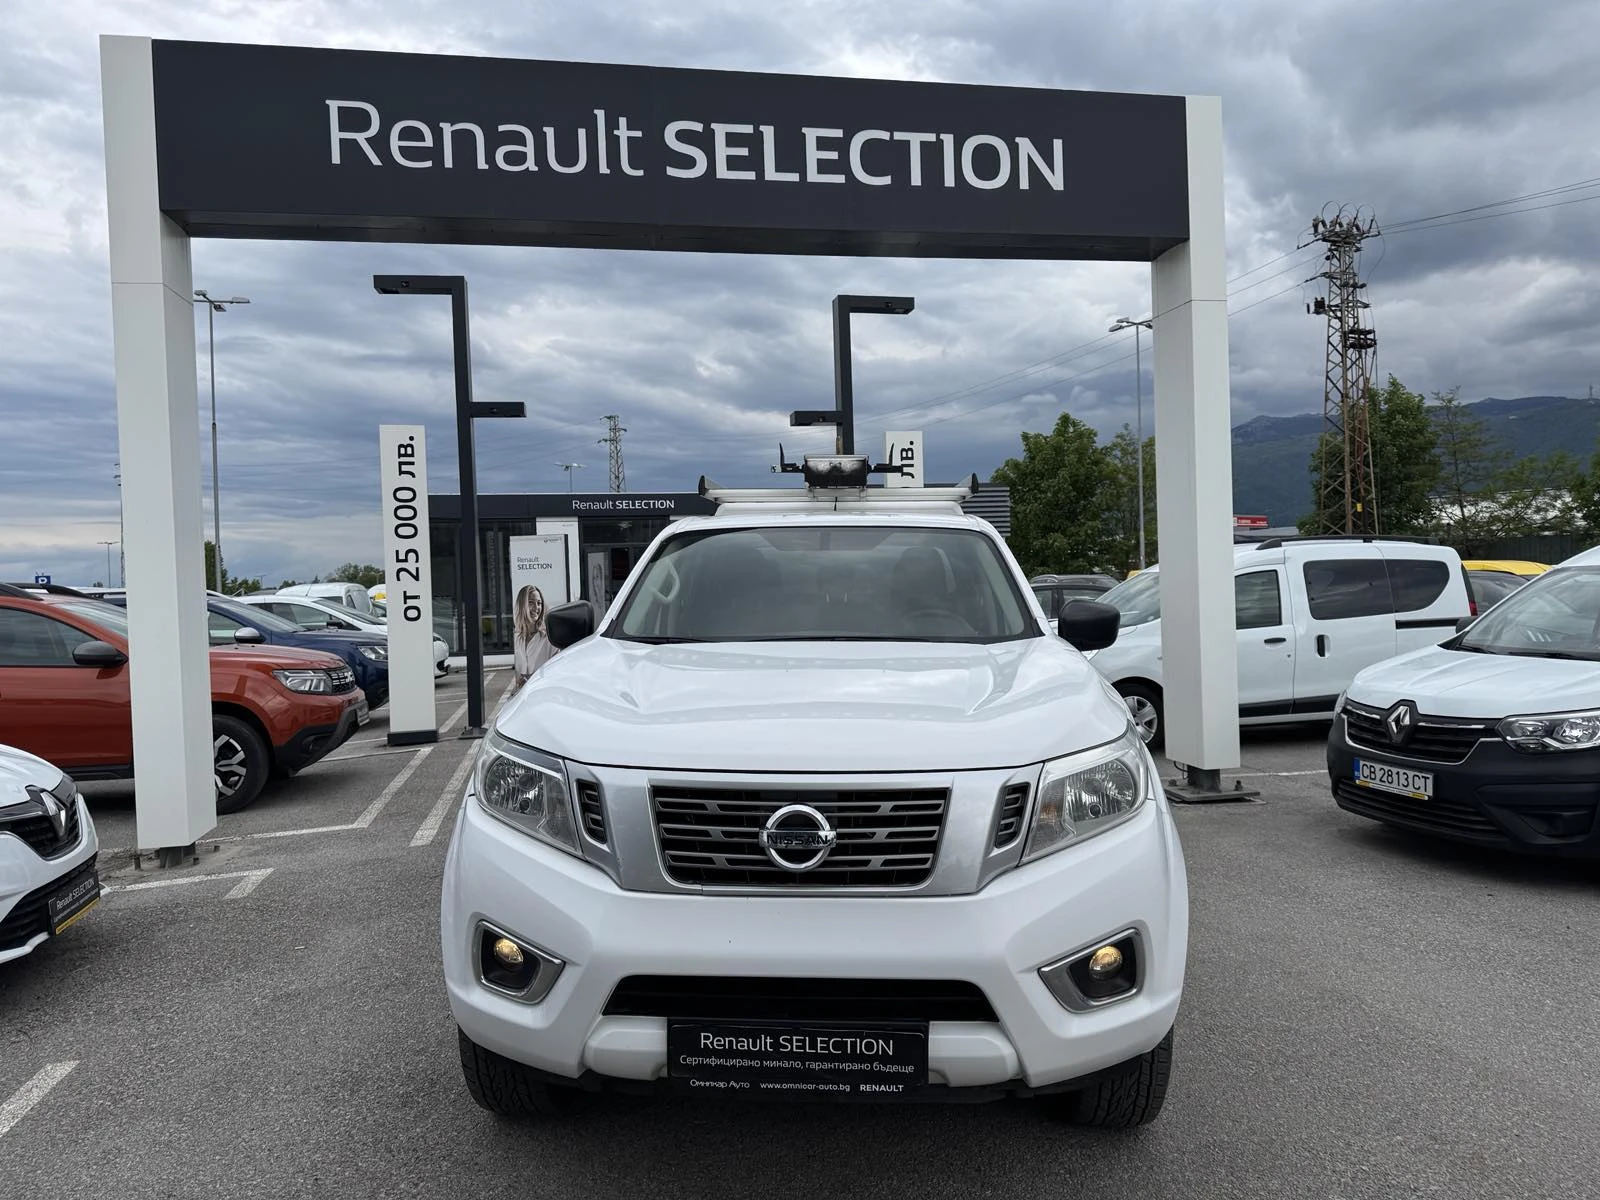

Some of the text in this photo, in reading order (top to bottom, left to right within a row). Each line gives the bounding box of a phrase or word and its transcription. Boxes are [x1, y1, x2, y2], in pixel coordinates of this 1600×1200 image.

[325, 99, 1065, 191] Renault SELECTION
[393, 486, 418, 540] 000
[572, 499, 675, 510] Renault SELECTION
[395, 548, 420, 582] 25
[517, 555, 540, 563] Renault
[1379, 767, 1410, 788] 2813
[766, 833, 829, 845] NISSAN
[700, 1032, 893, 1056] Renault SELECTION
[680, 1055, 915, 1073] Сертифицирано минало, гарантирано бъдеще
[760, 1082, 851, 1092] www.omnicar-auto.bg
[860, 1084, 904, 1092] RENAULT
